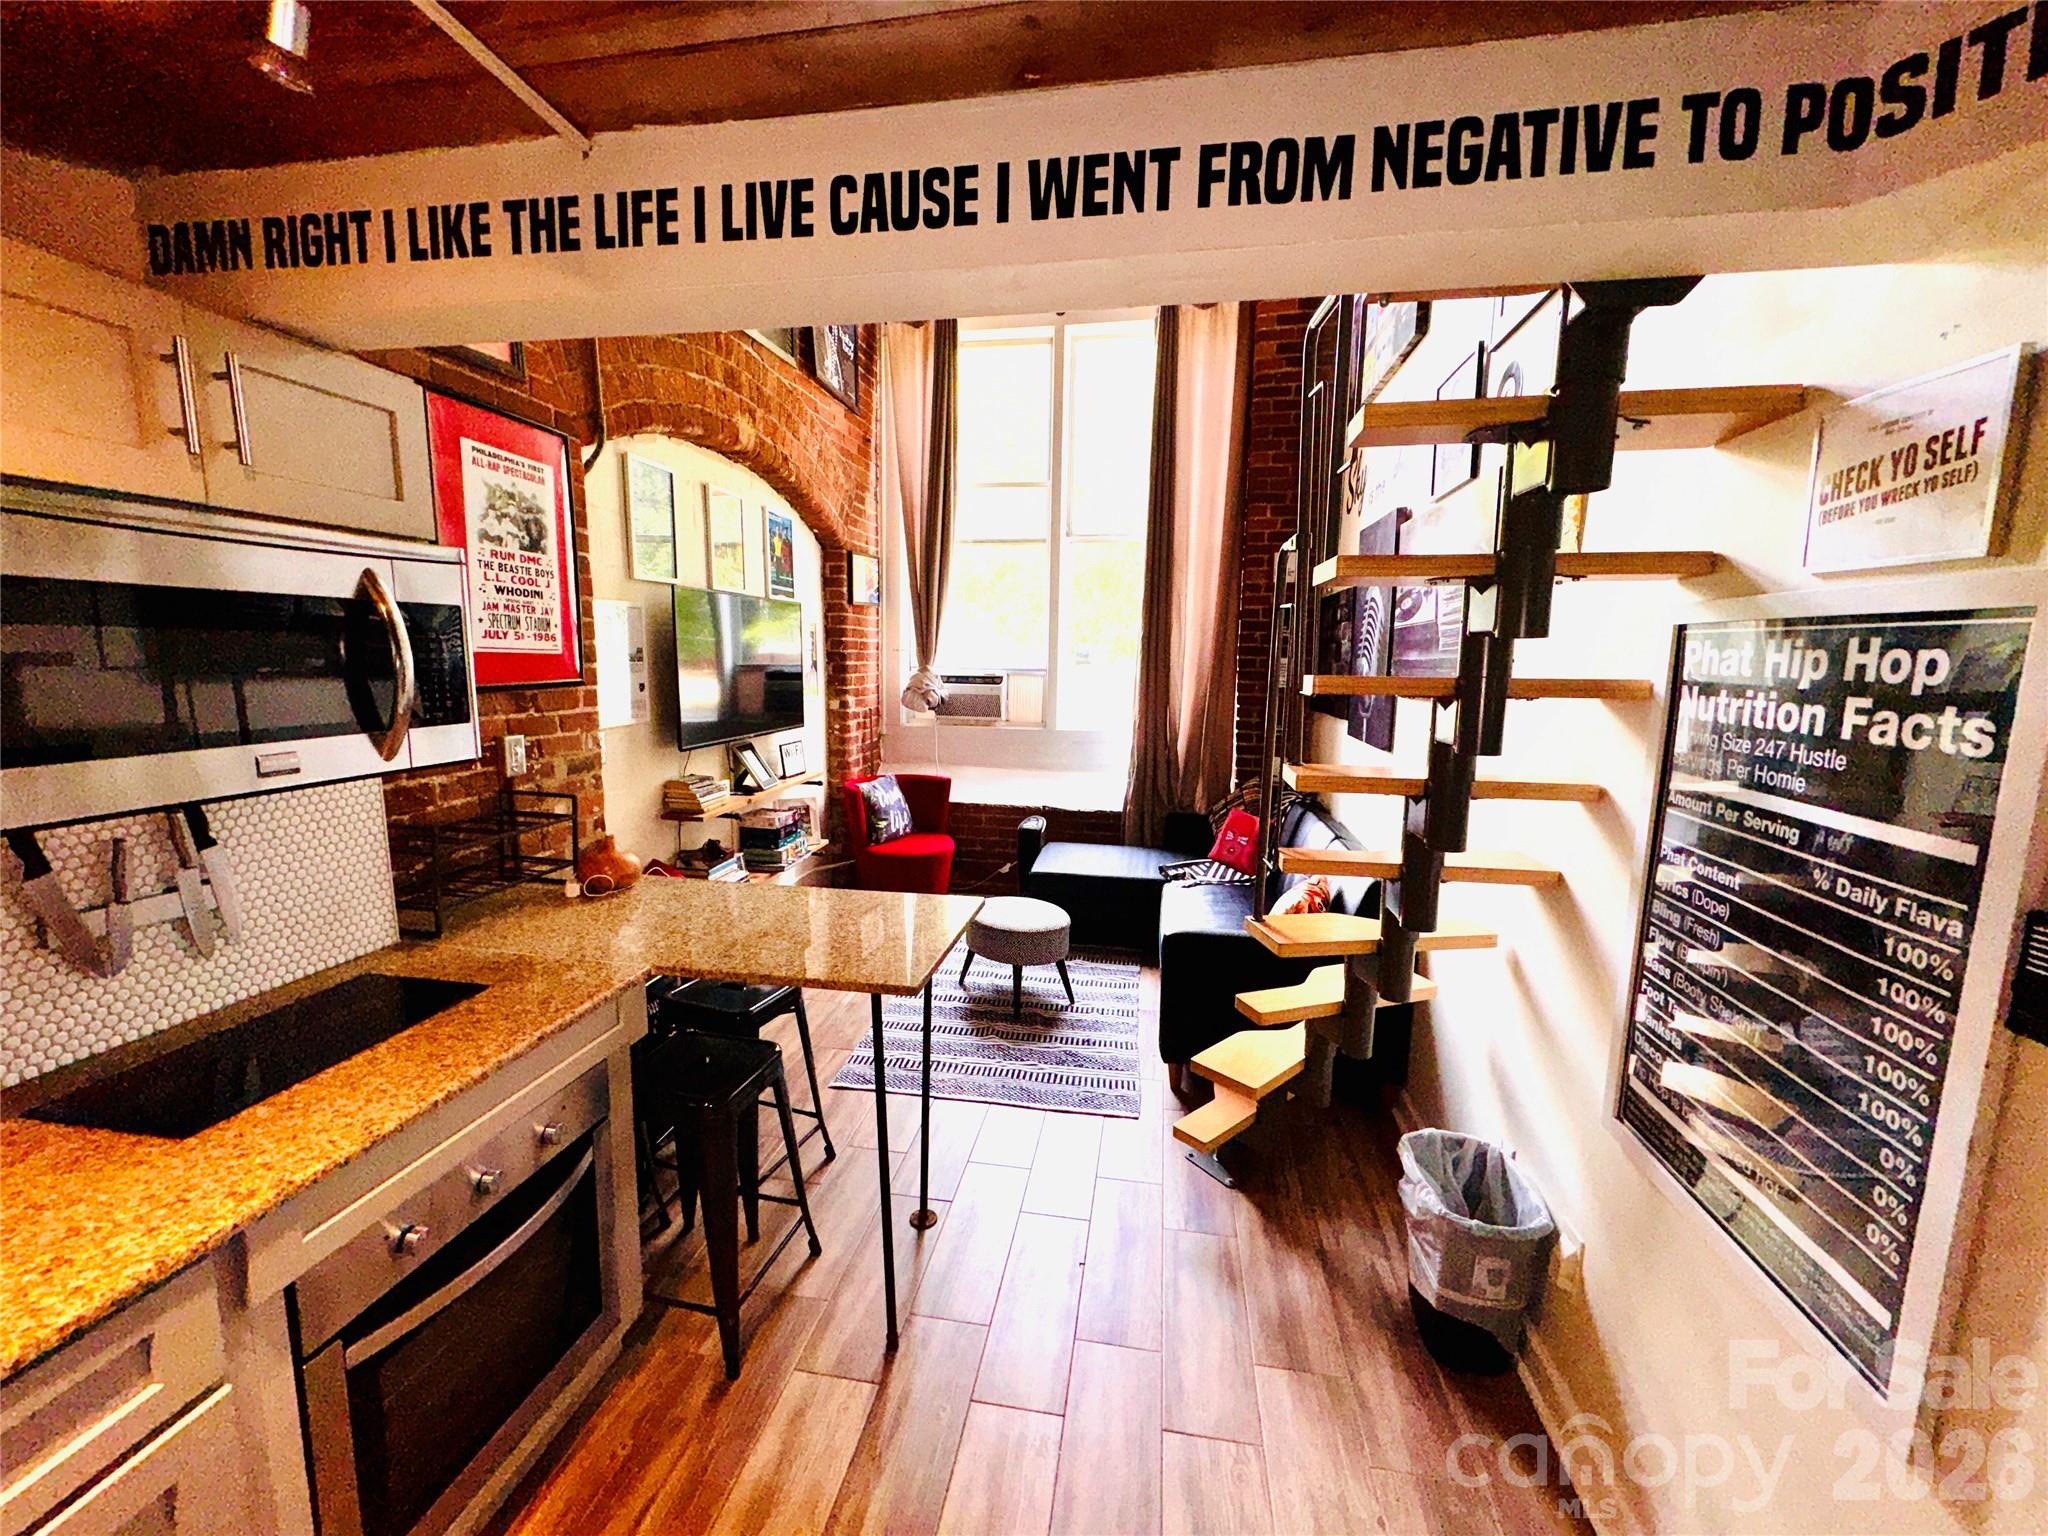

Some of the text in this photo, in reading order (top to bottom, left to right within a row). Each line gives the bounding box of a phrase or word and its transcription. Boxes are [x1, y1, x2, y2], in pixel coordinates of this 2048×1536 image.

[148, 217, 254, 276] DAMN
[264, 209, 372, 269] RIGHT
[382, 208, 396, 264] I
[407, 201, 492, 262] LIKE
[503, 194, 581, 256] THE
[594, 187, 679, 249] LIFE
[693, 185, 706, 244] I
[721, 177, 815, 243] LIVE
[829, 164, 979, 236] CAUSE
[996, 161, 1010, 224] I
[1028, 146, 1182, 221] WENT
[1197, 133, 1357, 209] FROM
[1370, 97, 1660, 193] NEGATIVE
[1681, 87, 1762, 164] TO
[528, 463, 544, 474] FIRST
[1819, 455, 1885, 506] CHECK
[1890, 441, 1919, 482] YO
[1923, 416, 1989, 471] SELF
[1859, 494, 1879, 513] YOU
[1881, 476, 1921, 506] WRECK
[1923, 474, 1940, 495] YO
[1941, 460, 1979, 489] SELF)
[477, 558, 555, 579] THE BEASTIE BOYS
[490, 549, 542, 566] RUN DMC
[483, 571, 551, 589] L.L. COOL J
[494, 584, 544, 600] WHODINI
[482, 601, 499, 612] JAM
[503, 603, 536, 615] MASTER
[540, 606, 554, 617] JAY
[487, 612, 552, 632] SPECTRUM STADIUM
[481, 629, 509, 640] JULY
[1683, 635, 1951, 696] Phat Hip Hop
[1680, 684, 1997, 759] Nutrition Facts
[1722, 732, 1751, 754] Size
[1754, 738, 1788, 759] 247
[1789, 742, 1847, 772] Hustle
[1727, 758, 1750, 780] Per
[1753, 764, 1807, 793] Homie
[1667, 790, 1713, 816] Amount
[1715, 803, 1741, 824] Per
[1743, 810, 1801, 846] Serving
[1660, 844, 1741, 891] Phat Content
[1651, 899, 1720, 949] Bling (Fresh)
[1692, 888, 1730, 922] (Dope)
[1835, 877, 1889, 915] Daily
[1894, 897, 1964, 939] Flava
[1649, 925, 1676, 952] Flow
[1884, 935, 1954, 981] 100%
[1641, 979, 1665, 1006] Foot
[1672, 971, 1707, 1006] (Booty
[1877, 977, 1946, 1024] 100%
[1634, 1030, 1663, 1065] Disco
[1870, 1016, 1937, 1066] 100%
[1863, 1055, 1930, 1106] 100%
[1857, 1092, 1924, 1147] 100%
[1879, 1148, 1916, 1187] 0%
[1872, 1185, 1908, 1226] 0%
[1866, 1223, 1901, 1265] 0%
